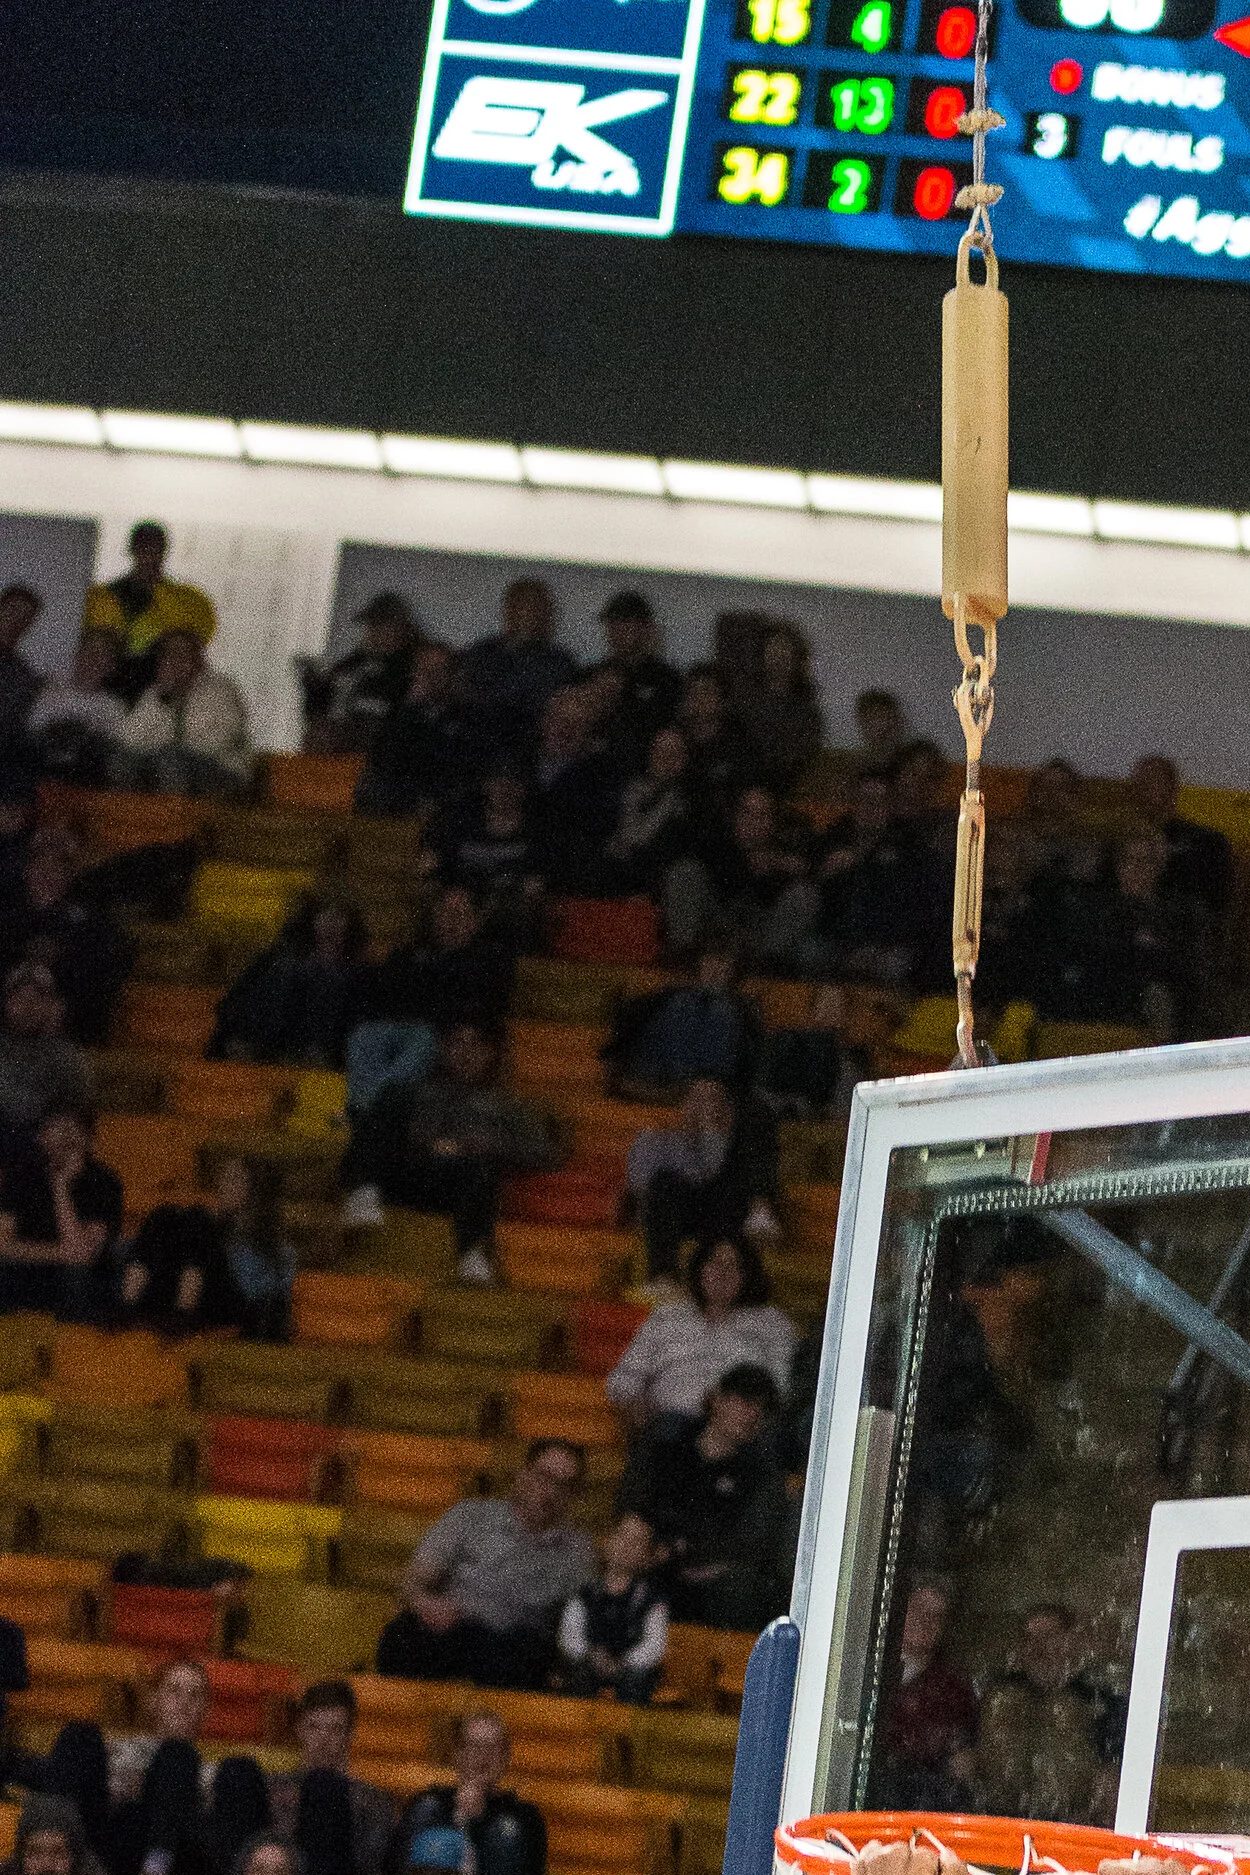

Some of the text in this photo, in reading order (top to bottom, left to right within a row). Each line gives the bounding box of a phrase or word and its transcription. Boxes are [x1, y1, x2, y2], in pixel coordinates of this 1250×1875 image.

[729, 69, 800, 126] 22
[1033, 112, 1225, 174] 3 FOULS
[719, 147, 788, 207] 34
[828, 159, 871, 214] 2
